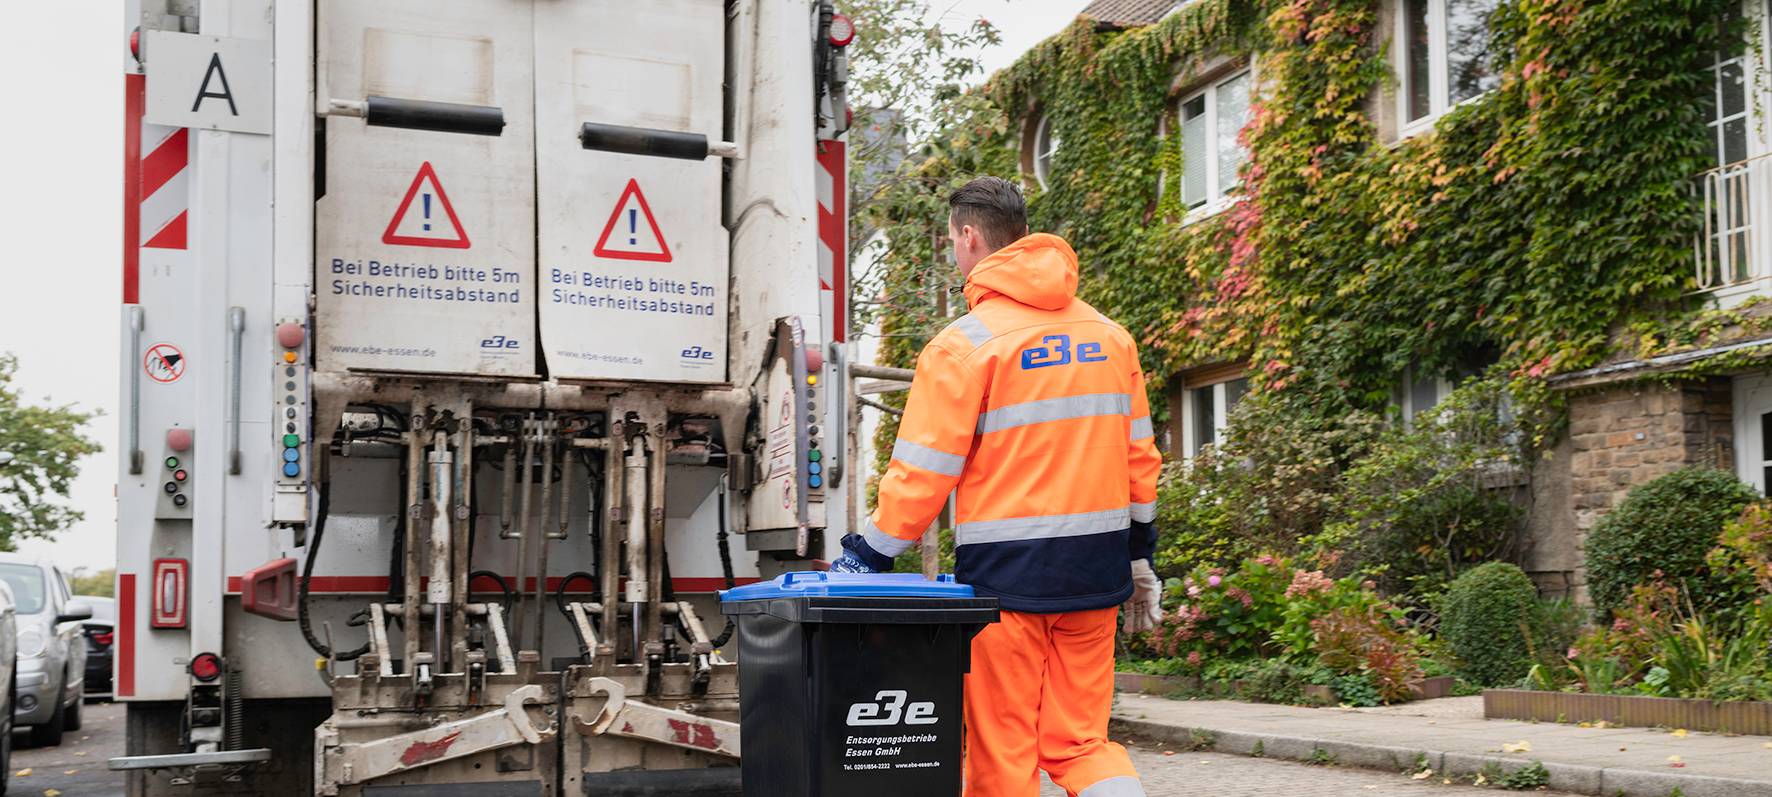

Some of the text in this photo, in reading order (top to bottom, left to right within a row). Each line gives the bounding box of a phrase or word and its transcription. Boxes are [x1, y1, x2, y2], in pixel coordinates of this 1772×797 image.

[191, 52, 239, 117] A
[331, 258, 520, 283] Bei Betrieb bitte 5m
[331, 280, 520, 303] Sicherheitsabstand
[551, 268, 715, 297] Bei Betrieb bitte 5m
[552, 289, 715, 316] Sicherheitsabstand
[330, 344, 436, 357] www.ebe-essen.de
[556, 350, 643, 365] www.ebe-essen.de
[846, 734, 937, 745] Entsorgungsbetriebe
[845, 746, 901, 757] Essen GmbH
[895, 761, 940, 769] www.ebe-essen.de
